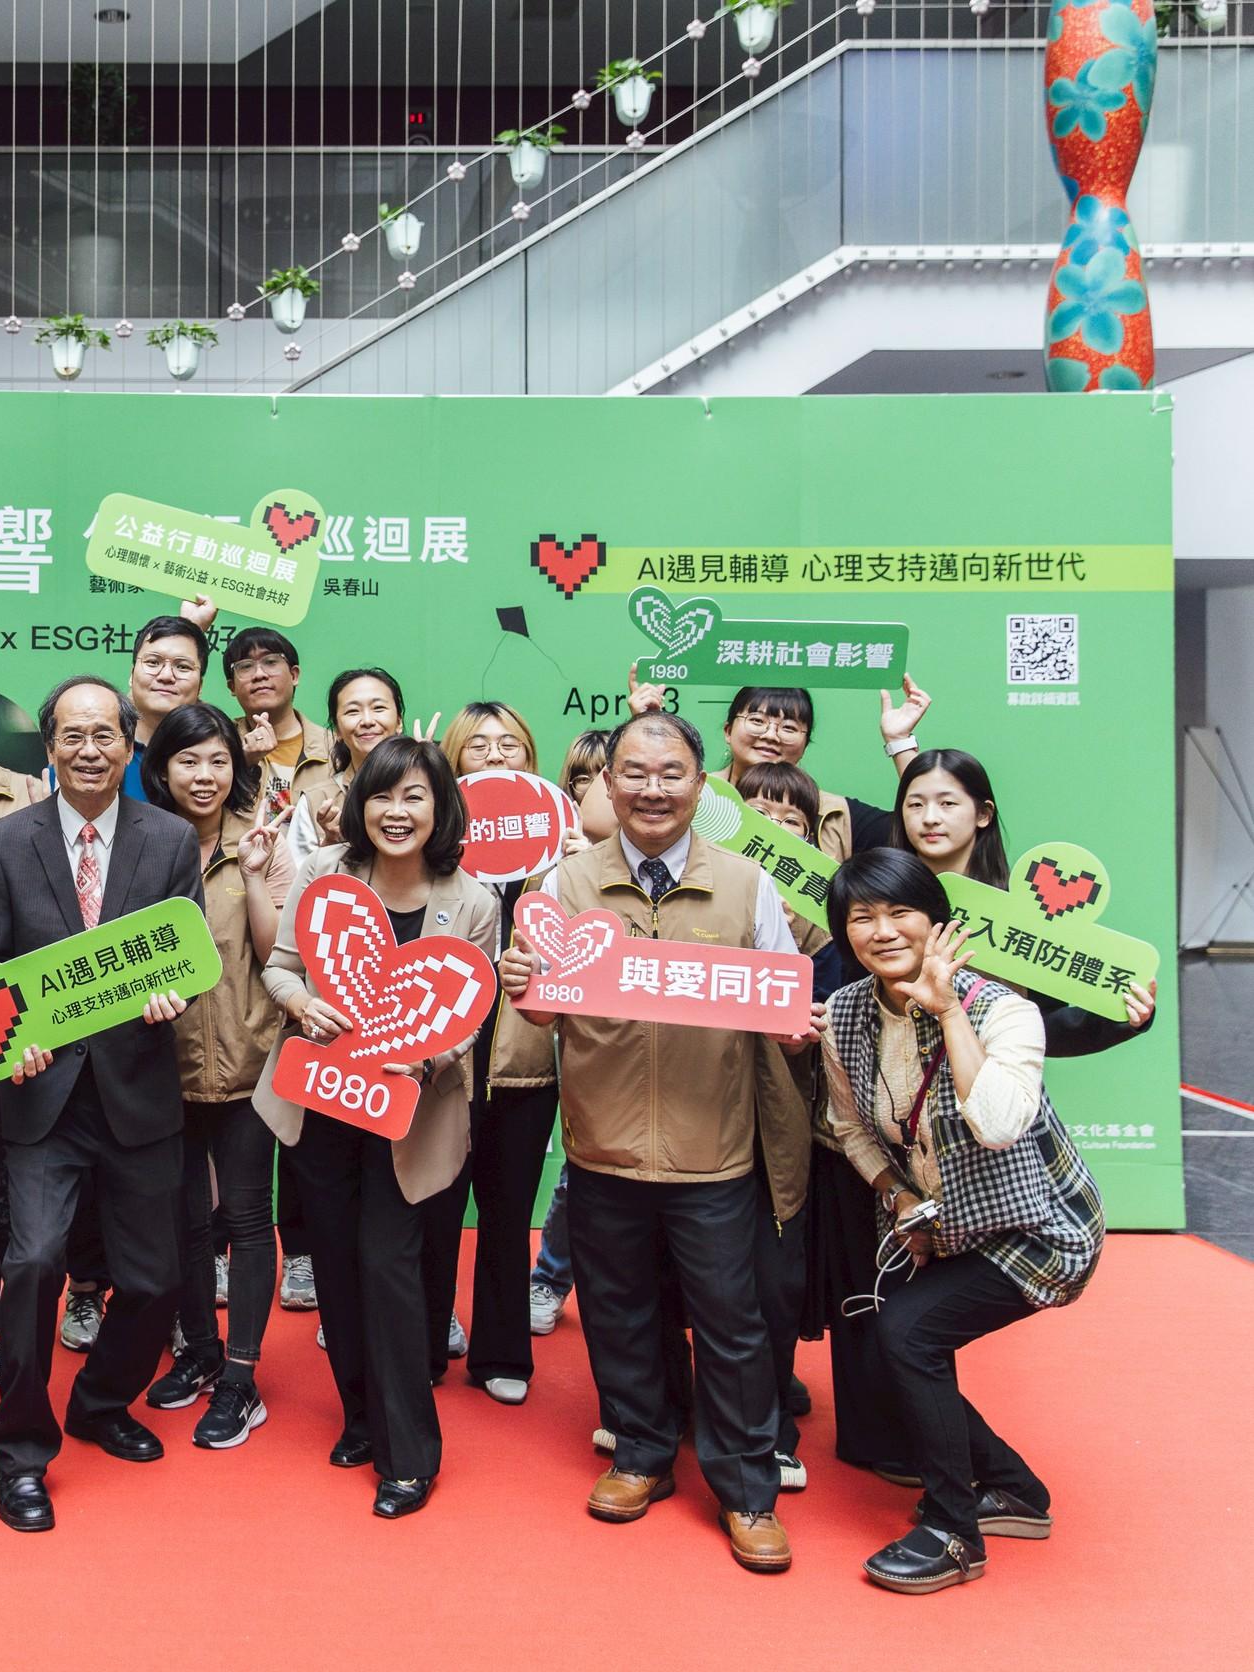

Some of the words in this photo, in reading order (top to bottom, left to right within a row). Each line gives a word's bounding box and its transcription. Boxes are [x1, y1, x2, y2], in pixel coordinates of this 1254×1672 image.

[114, 514, 299, 584] 公益行動巡迴展
[638, 553, 789, 584] AI遇見輔導
[802, 552, 1086, 583] 心理支持邁向新世代
[104, 545, 150, 569] 心理關懷
[164, 560, 210, 585] 藝術公益
[221, 577, 290, 607] ESG社會共好
[323, 578, 379, 597] 吳春山
[649, 664, 688, 680] 1980
[716, 640, 895, 669] 深耕社會影響
[458, 812, 551, 844] 的迴響
[41, 923, 181, 998] AI遇見輔導
[51, 959, 195, 1026] 心理支持邁向新世代
[536, 982, 584, 1004] 1980
[618, 956, 800, 1008] 與愛同行
[303, 1060, 391, 1119] 1980
